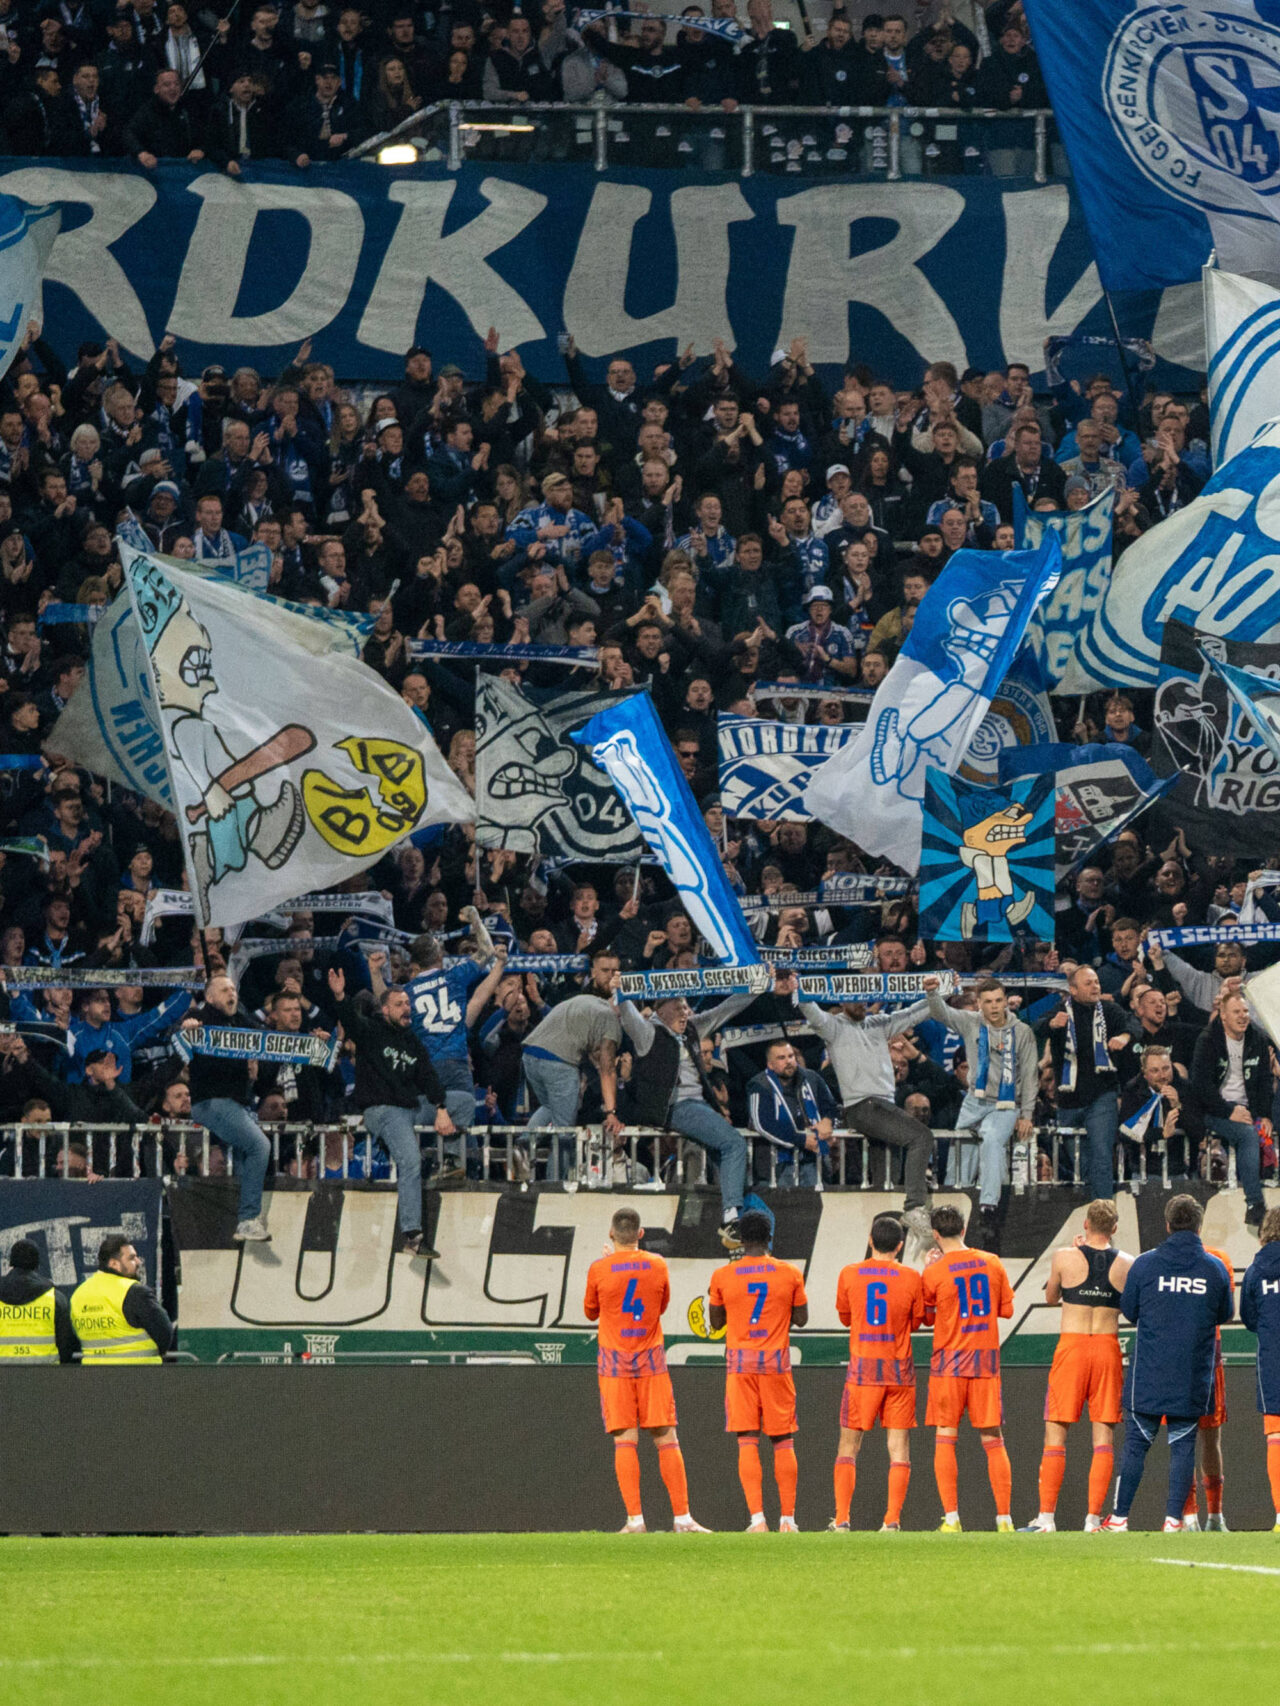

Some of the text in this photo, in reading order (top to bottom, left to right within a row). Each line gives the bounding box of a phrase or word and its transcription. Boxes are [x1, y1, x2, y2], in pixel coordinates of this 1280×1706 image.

[575, 792, 626, 829] 04
[1148, 929, 1176, 948] FC
[621, 967, 750, 994] WIR WERDEN SIEGEN!
[801, 974, 926, 995] WIR WERDEN SIEGE
[414, 986, 463, 1034] 24
[210, 1030, 261, 1051] WERDEN
[265, 1034, 313, 1056] SIEGEN!
[953, 1272, 992, 1319] 19
[1078, 1288, 1112, 1299] CATAPULT
[1158, 1275, 1208, 1295] HRS
[621, 1277, 645, 1322] 4
[747, 1281, 769, 1325] 7
[865, 1281, 888, 1327] 6
[74, 1316, 116, 1330] ORDNER
[13, 1345, 31, 1356] 353
